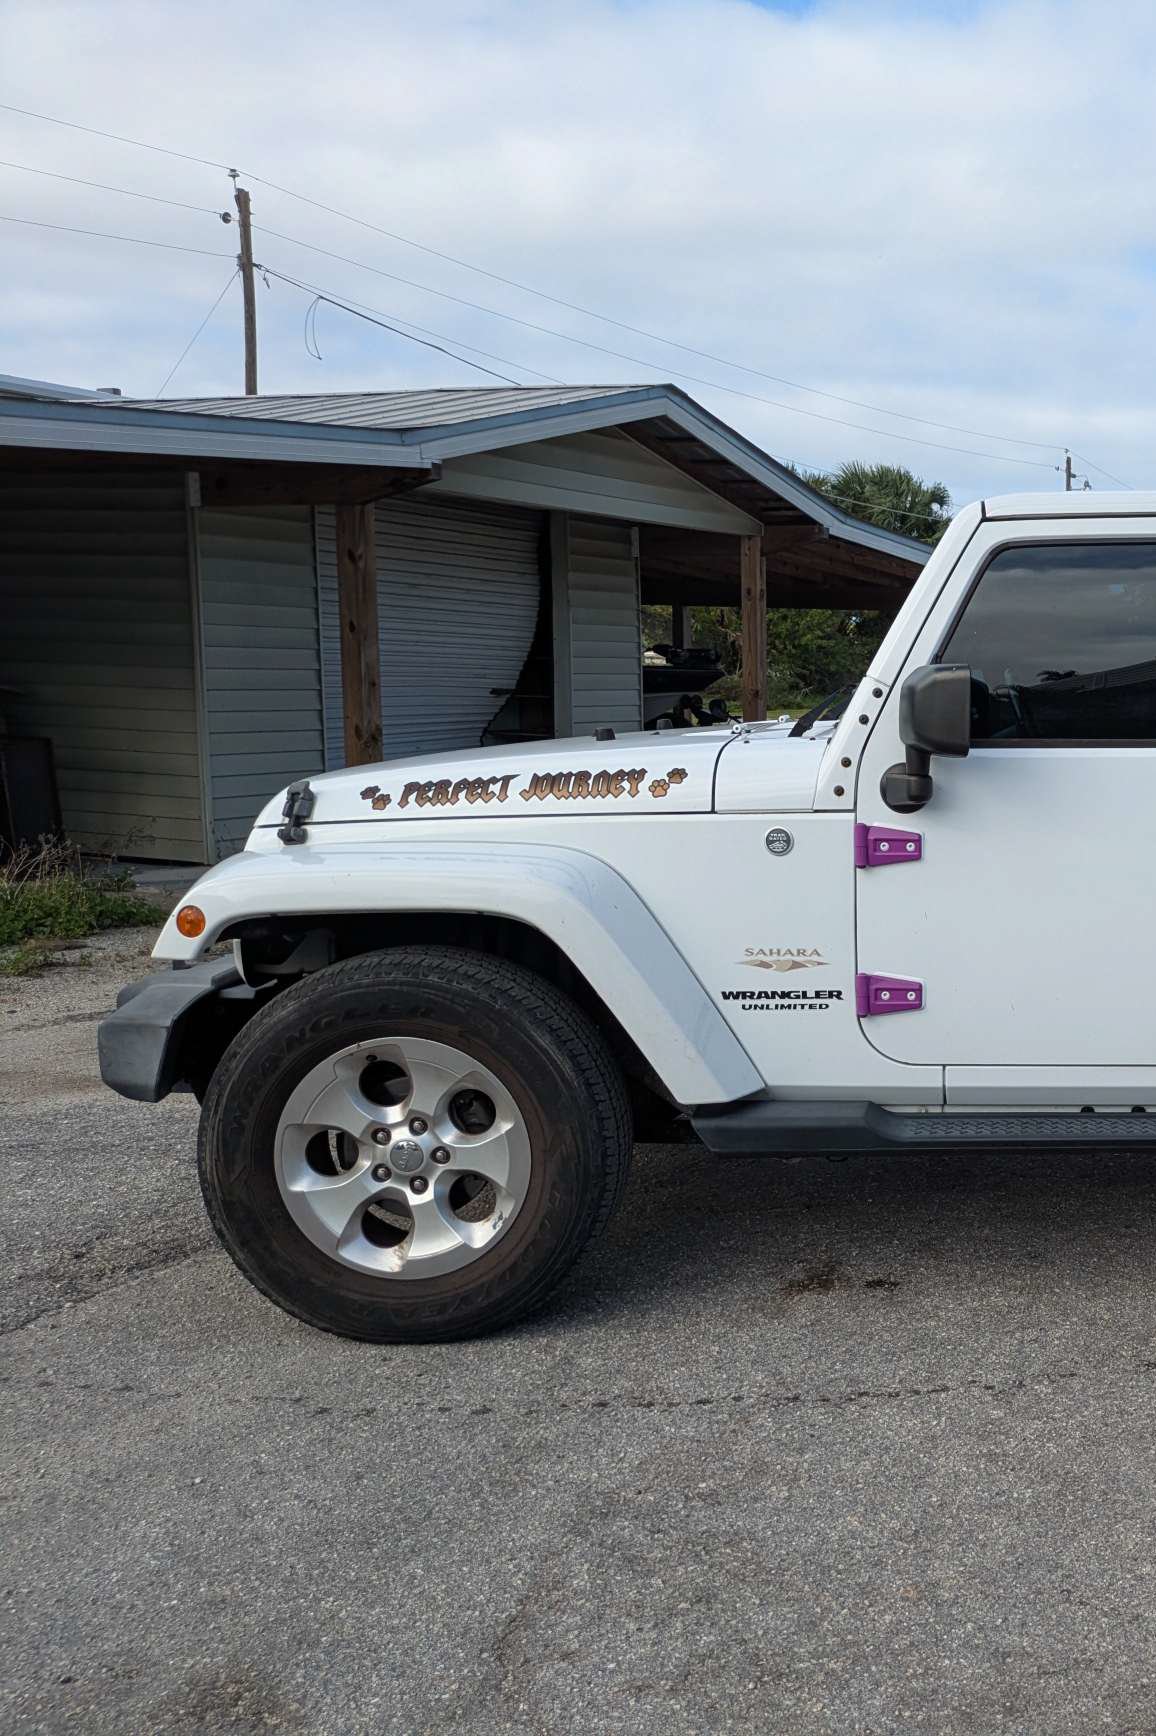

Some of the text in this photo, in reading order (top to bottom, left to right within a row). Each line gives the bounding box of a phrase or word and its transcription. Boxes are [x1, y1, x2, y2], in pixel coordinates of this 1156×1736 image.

[397, 767, 648, 808] PERFECT JOURNEY
[744, 948, 823, 957] SAHARA
[720, 990, 844, 1001] WRANGLER
[741, 1003, 830, 1011] UNLIMITED
